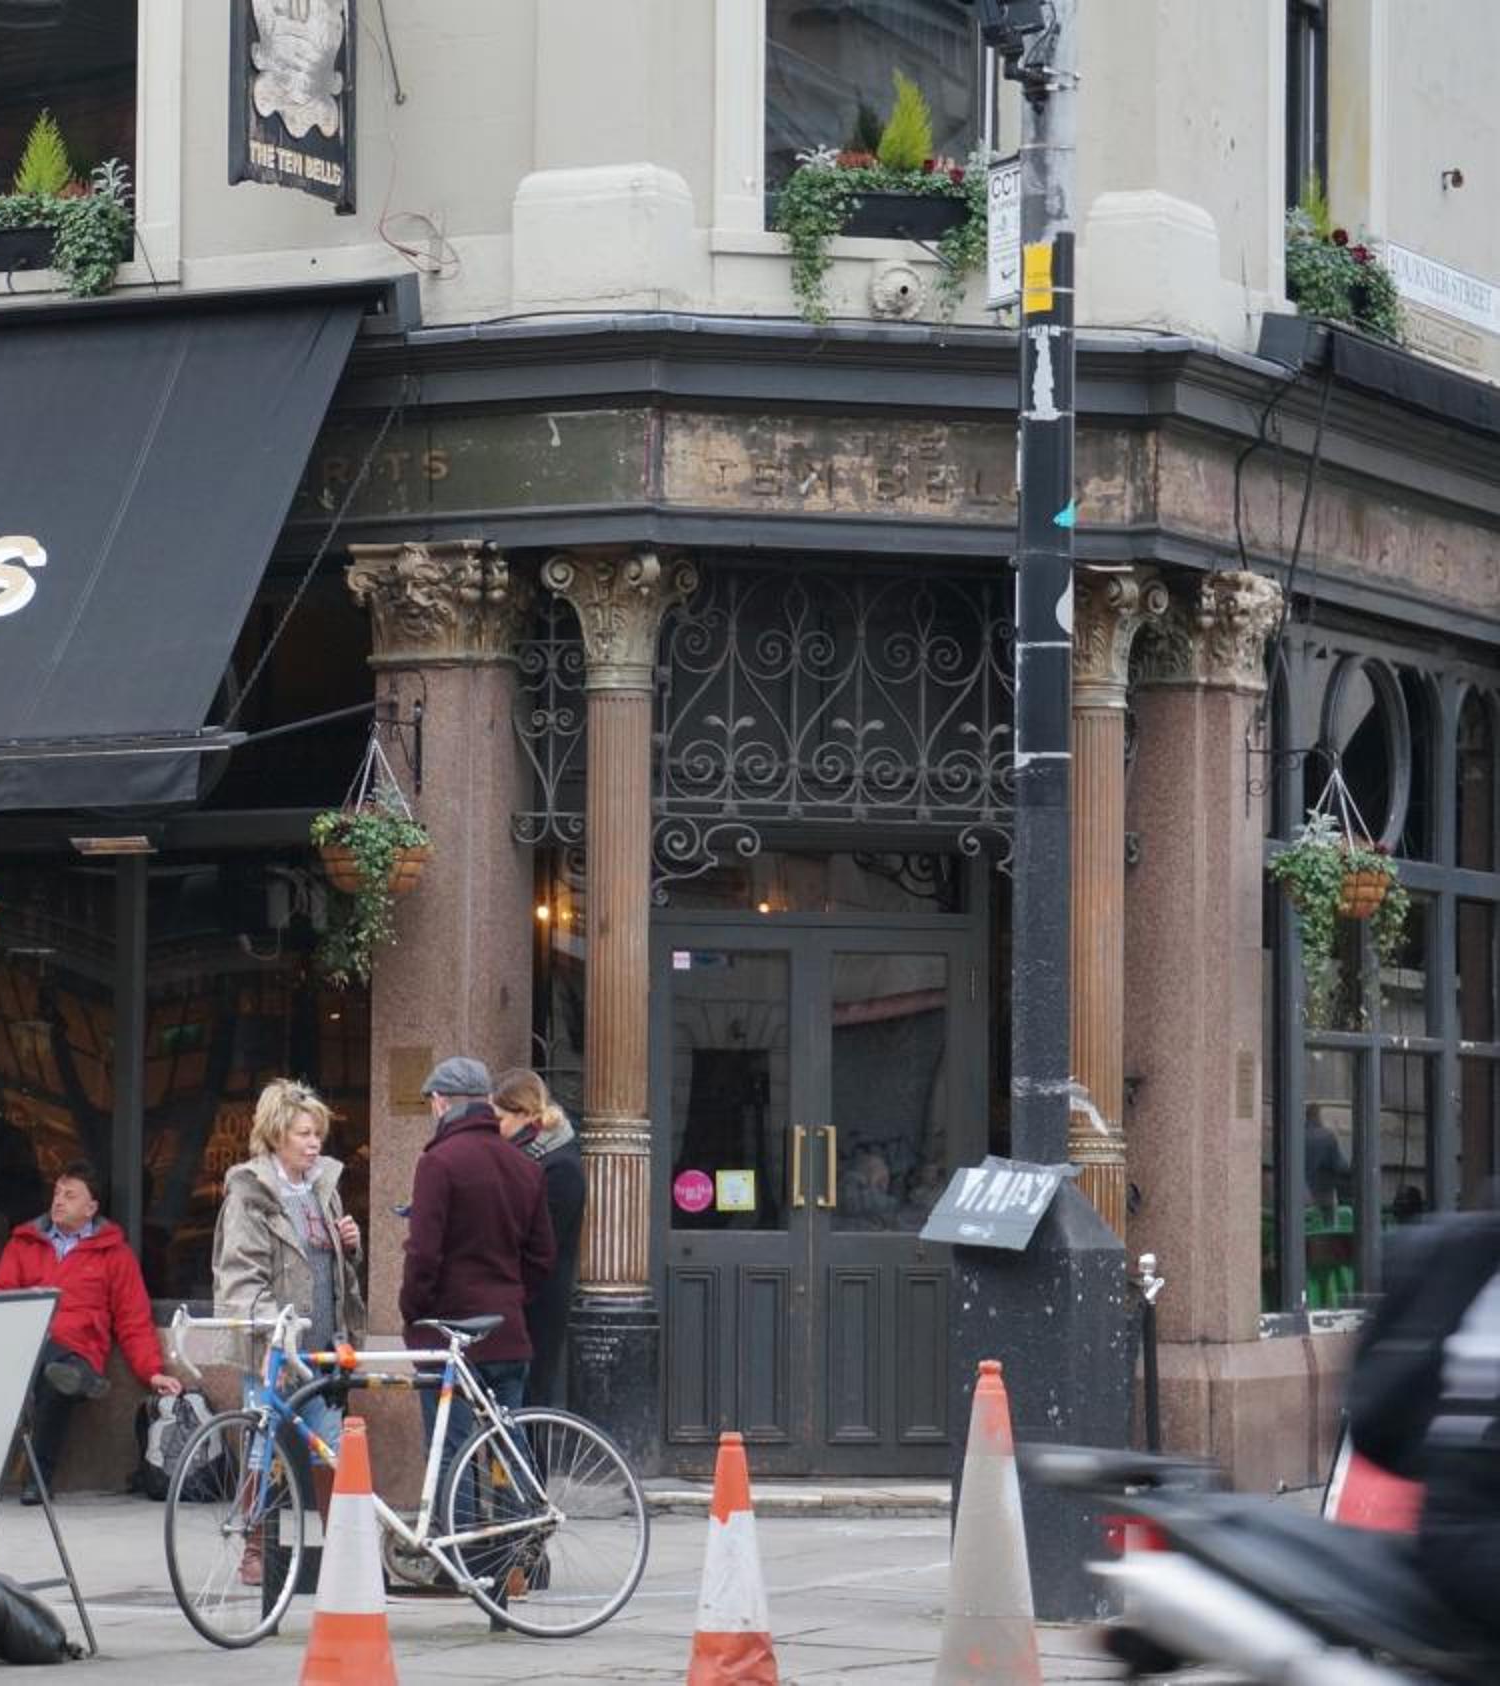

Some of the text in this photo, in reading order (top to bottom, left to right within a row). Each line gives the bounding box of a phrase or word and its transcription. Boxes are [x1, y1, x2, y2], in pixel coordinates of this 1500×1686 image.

[249, 139, 342, 188] THE TEN BELLS
[990, 170, 1021, 200] CCT
[1451, 275, 1493, 314] STREET
